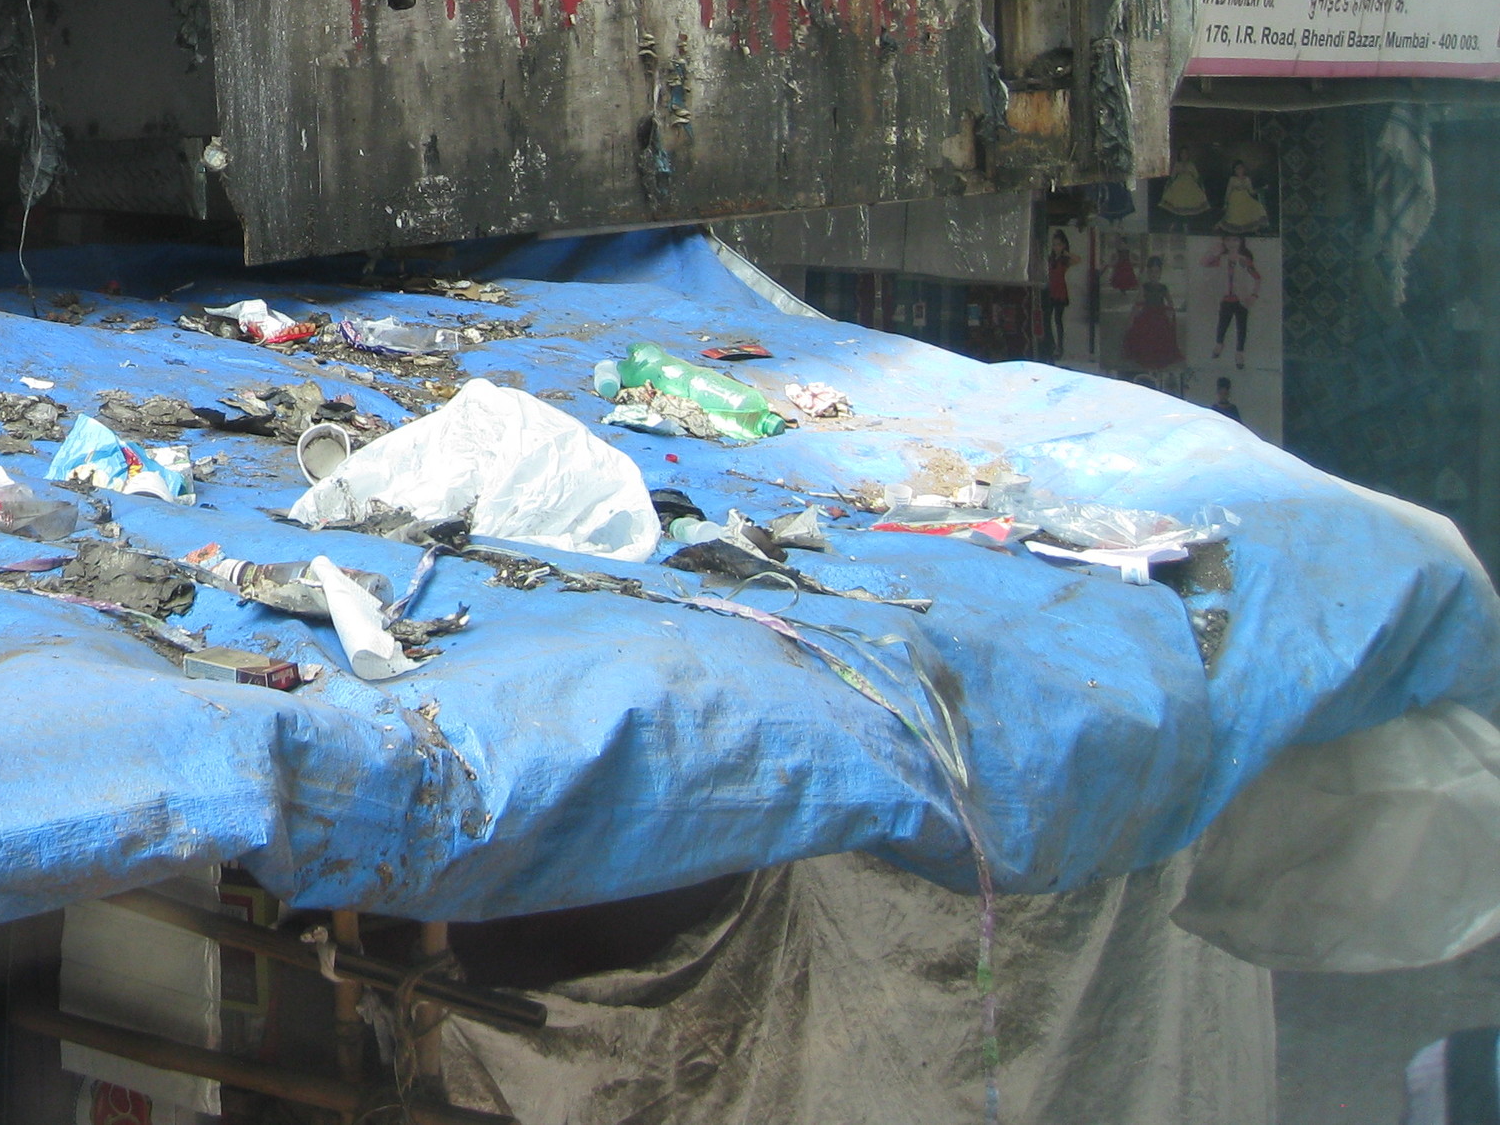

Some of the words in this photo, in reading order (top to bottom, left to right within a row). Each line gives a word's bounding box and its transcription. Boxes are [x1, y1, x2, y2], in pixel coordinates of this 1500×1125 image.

[1205, 25, 1231, 47] 176,
[1235, 26, 1257, 45] I.R.
[1261, 27, 1297, 48] Road,
[1301, 28, 1344, 48] Bhendi
[1347, 30, 1381, 50] Bazar,
[1385, 32, 1430, 49] Mumbai
[1438, 33, 1458, 50] 400
